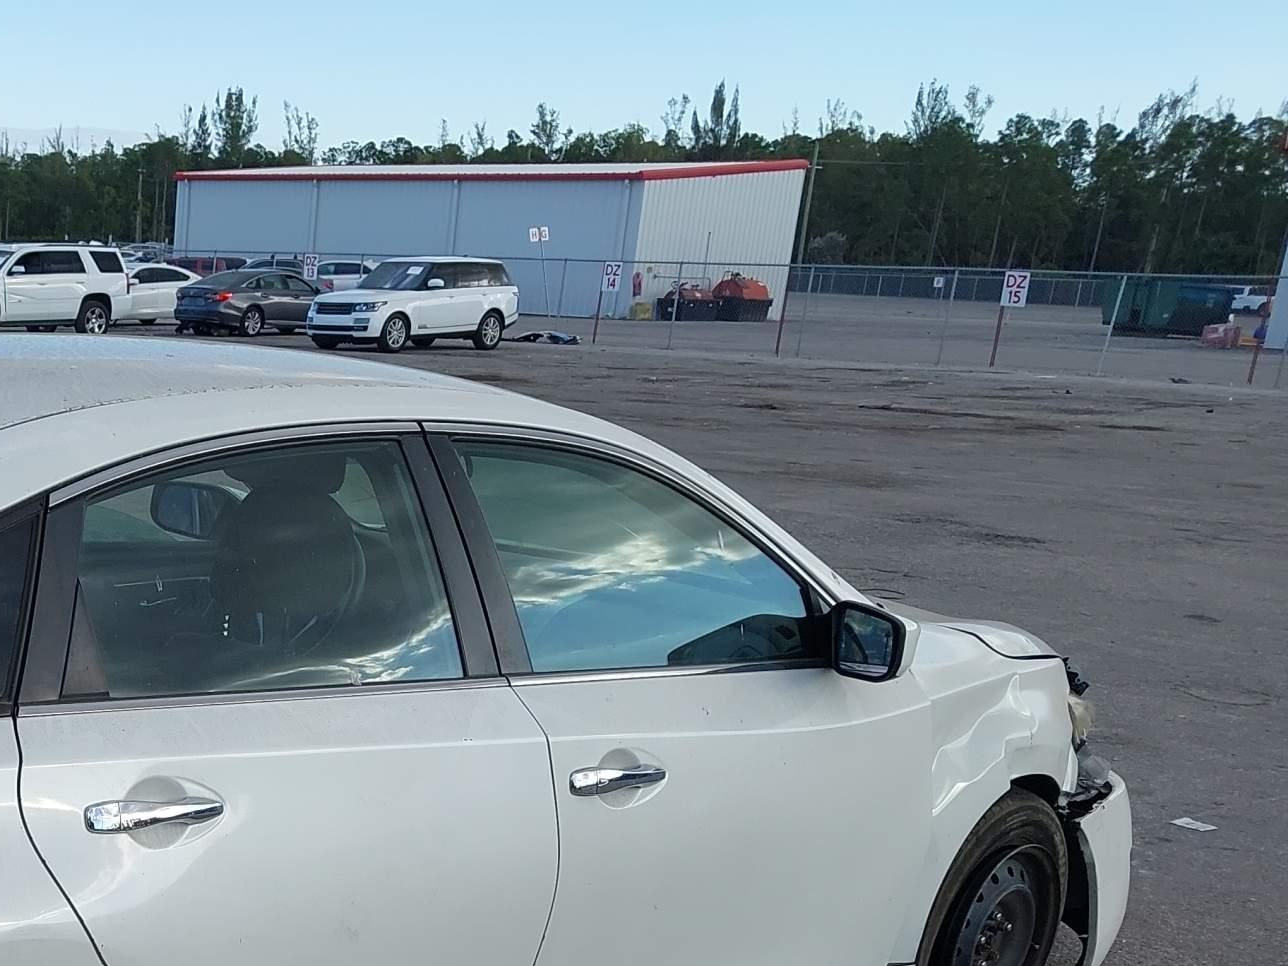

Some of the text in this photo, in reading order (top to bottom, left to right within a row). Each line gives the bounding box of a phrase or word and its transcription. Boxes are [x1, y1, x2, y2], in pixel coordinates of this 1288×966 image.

[305, 255, 317, 267] DZ
[306, 267, 315, 278] 13
[605, 263, 621, 277] DZ
[607, 277, 616, 289] 14
[1006, 274, 1028, 289] DZ
[1007, 290, 1022, 304] 15
